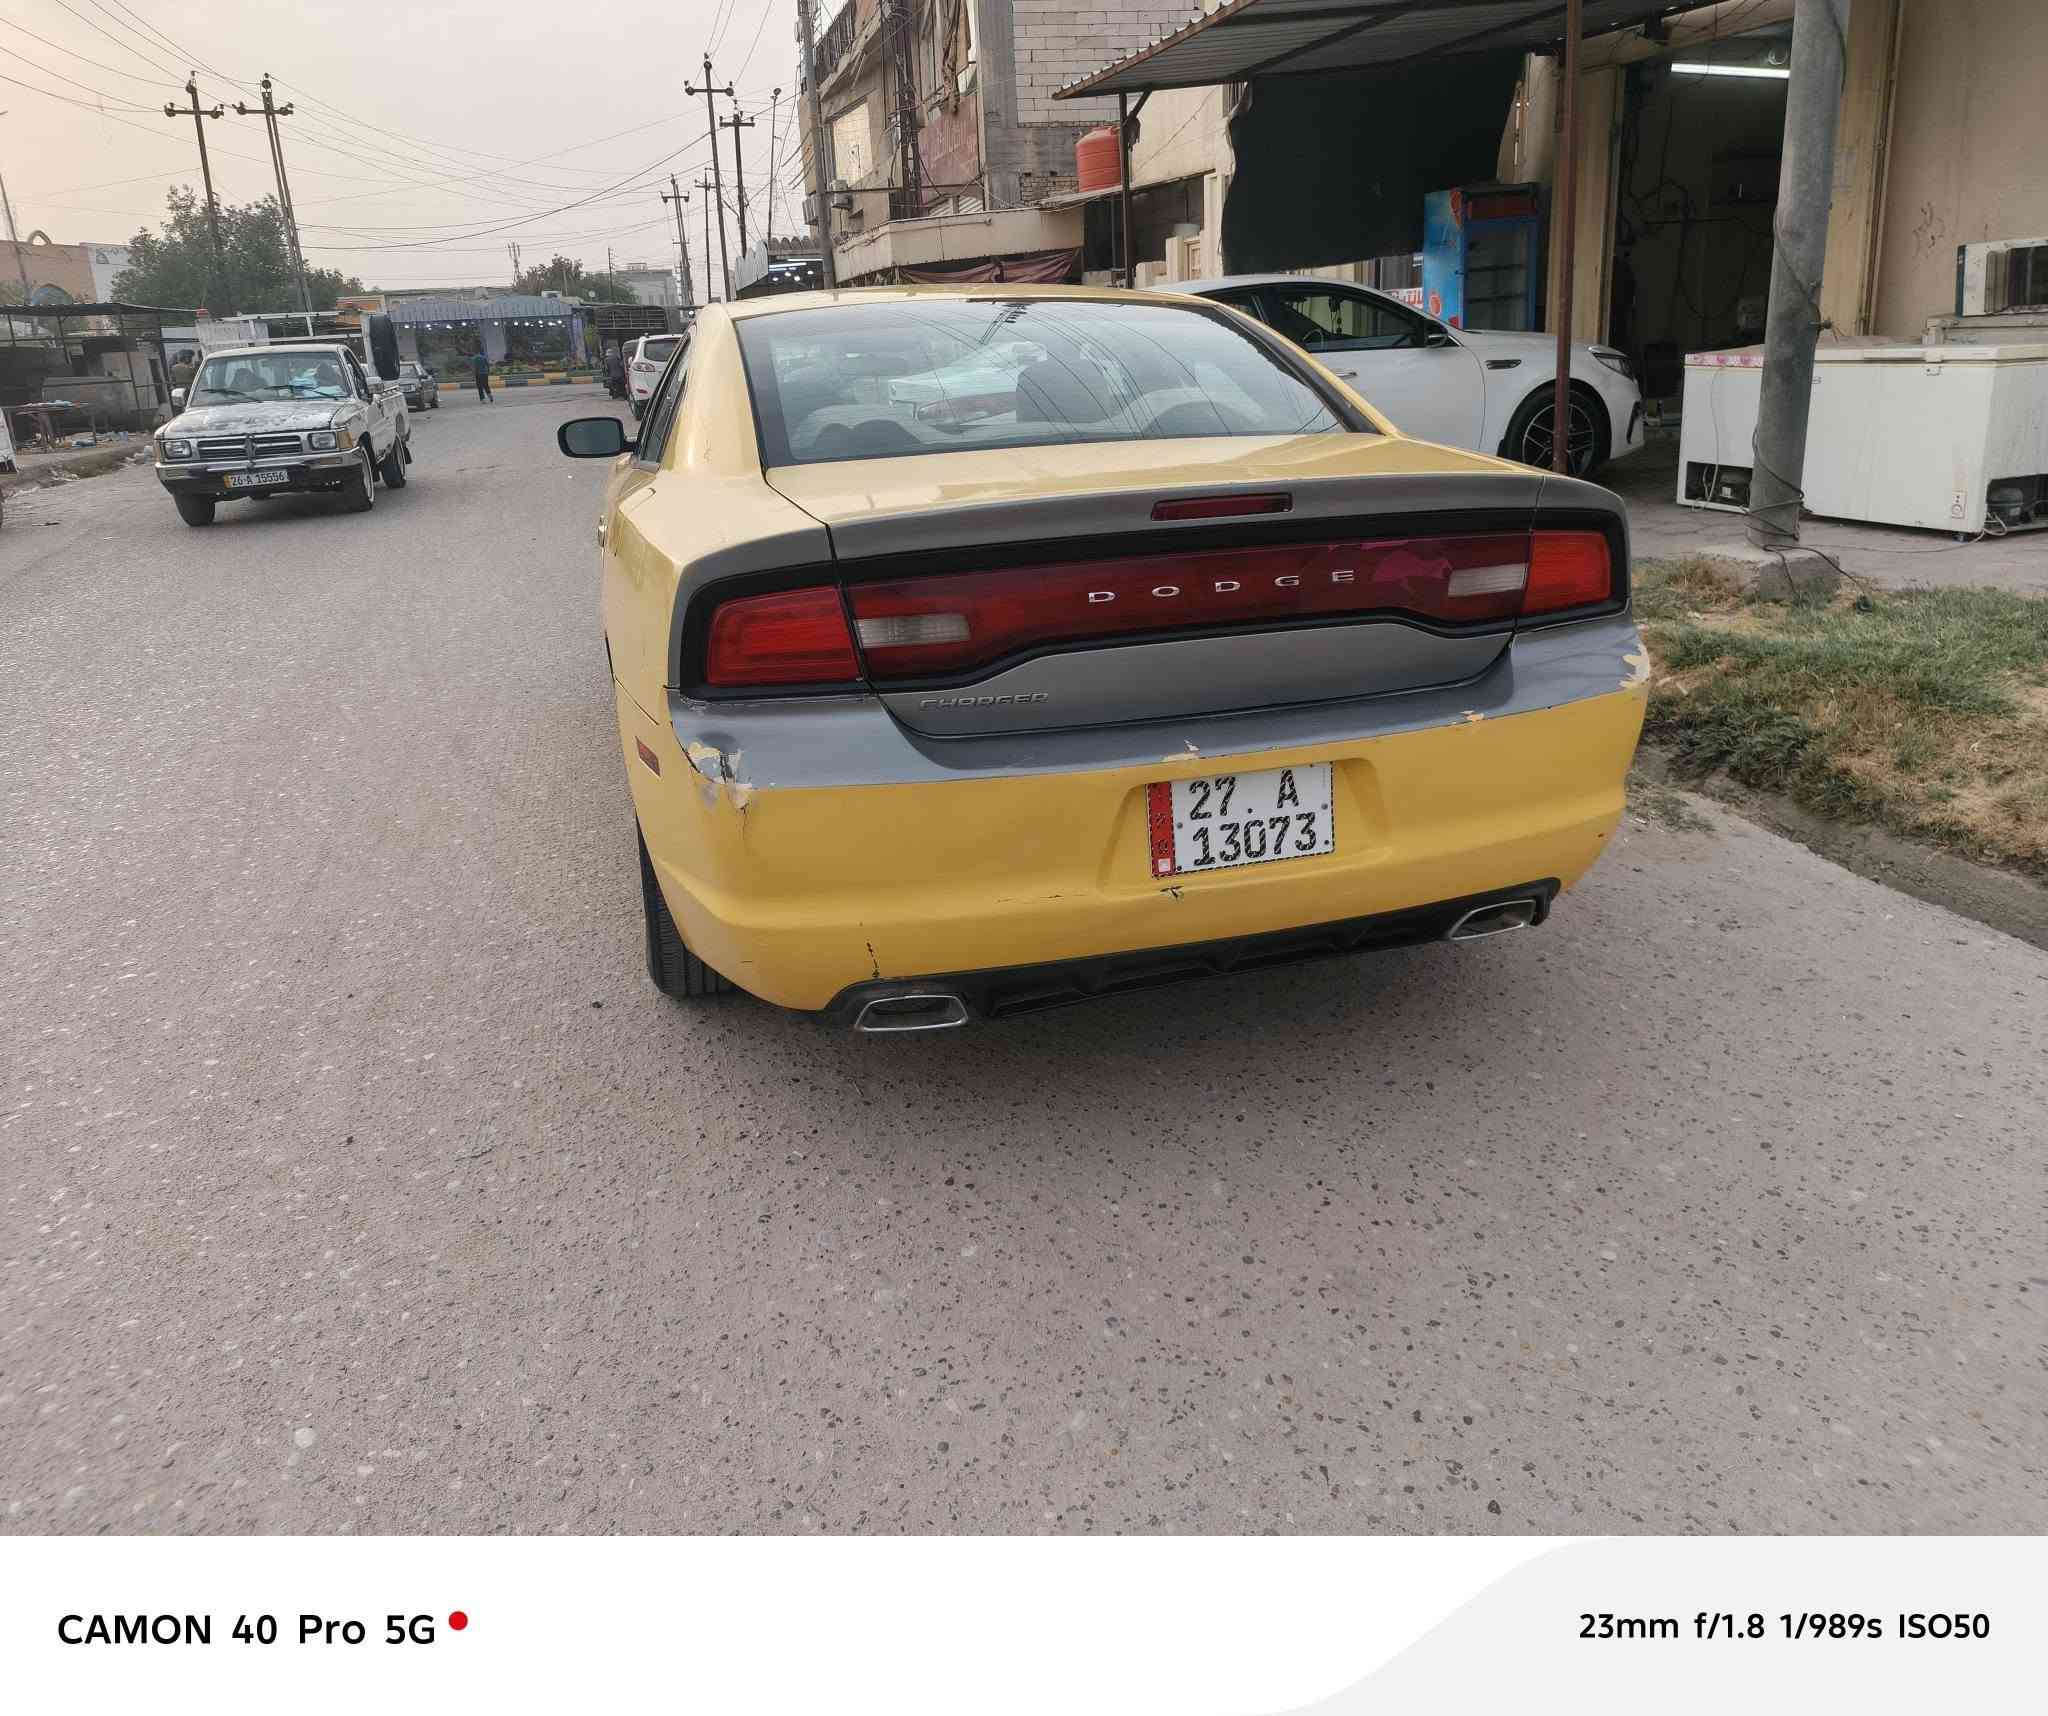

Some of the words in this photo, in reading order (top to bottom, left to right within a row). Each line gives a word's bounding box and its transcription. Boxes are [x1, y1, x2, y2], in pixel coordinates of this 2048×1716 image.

[1088, 569, 1354, 603] DODGE
[1189, 776, 1236, 820] 27
[1277, 769, 1299, 808] A
[1193, 812, 1317, 866] 13073
